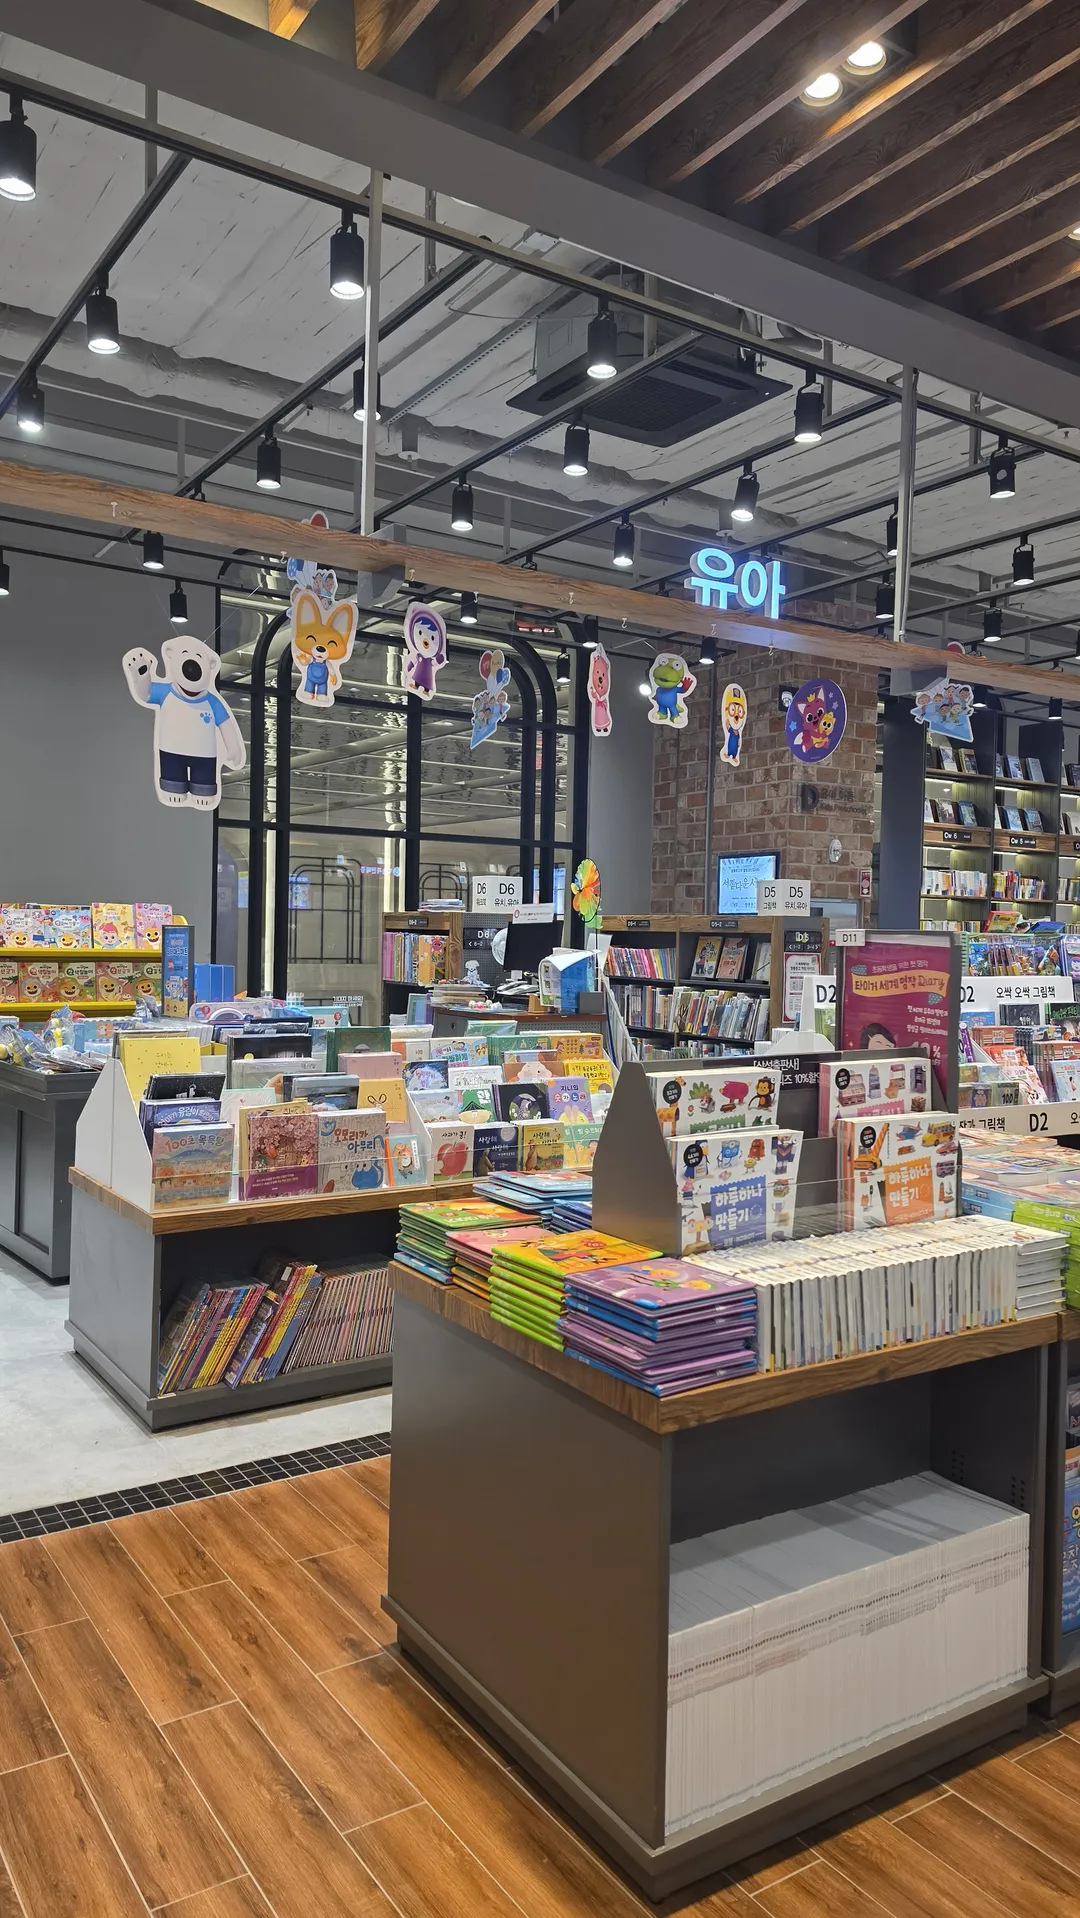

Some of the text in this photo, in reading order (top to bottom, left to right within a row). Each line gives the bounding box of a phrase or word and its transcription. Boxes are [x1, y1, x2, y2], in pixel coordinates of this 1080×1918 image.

[688, 547, 786, 619] 유아
[477, 883, 487, 894] D6
[499, 883, 515, 895] D6
[764, 886, 776, 898] D5
[789, 886, 804, 898] D5
[842, 933, 857, 943] D11
[854, 975, 945, 992] 타이거 세계 명작 Diary
[816, 984, 836, 1003] D2
[996, 987, 1013, 999] 오싹
[1014, 987, 1030, 999] 오싹
[1032, 986, 1056, 999] 그림책
[561, 1084, 578, 1092] 지니의
[178, 1106, 199, 1118] 유령이
[979, 1117, 1005, 1131] 그림책
[1029, 1112, 1080, 1132] D2 오
[334, 1128, 369, 1143] 오모리가
[478, 1135, 498, 1145] 사랑해
[533, 1131, 550, 1139] 사랑해
[165, 1135, 196, 1152] 100초
[347, 1139, 376, 1154] 아무리
[888, 1163, 930, 1185] 하루하나
[715, 1183, 764, 1207] 하루하나
[889, 1186, 919, 1208] 만들기
[715, 1207, 749, 1231] 만들기
